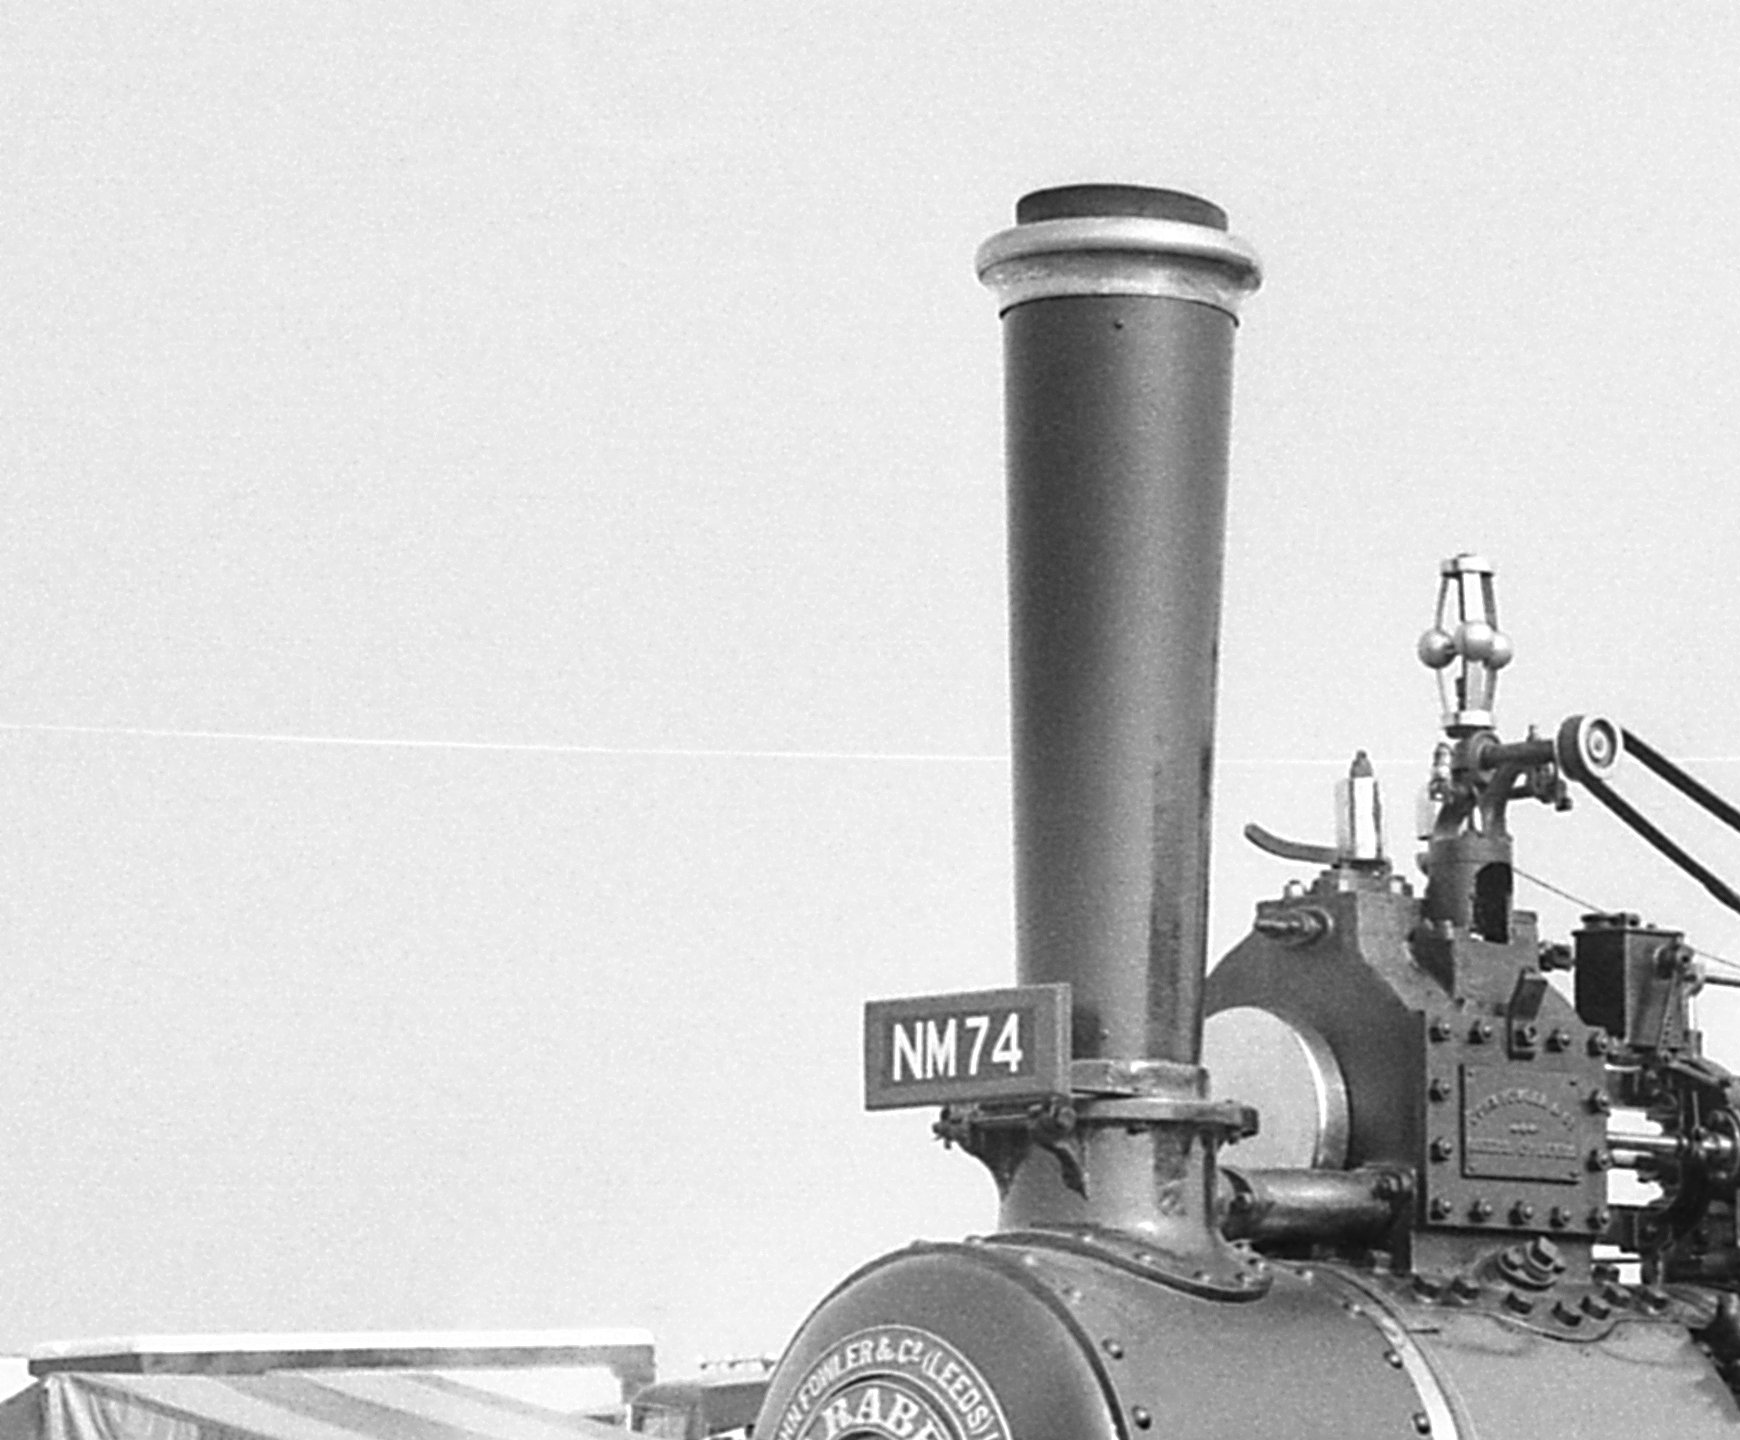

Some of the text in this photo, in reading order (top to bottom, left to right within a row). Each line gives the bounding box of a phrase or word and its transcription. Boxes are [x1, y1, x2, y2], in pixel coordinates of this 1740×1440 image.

[893, 1012, 1023, 1082] NM 74
[799, 1339, 874, 1411] FOWLER
[876, 1337, 894, 1361] &
[922, 1350, 994, 1435] (LEEDS)
